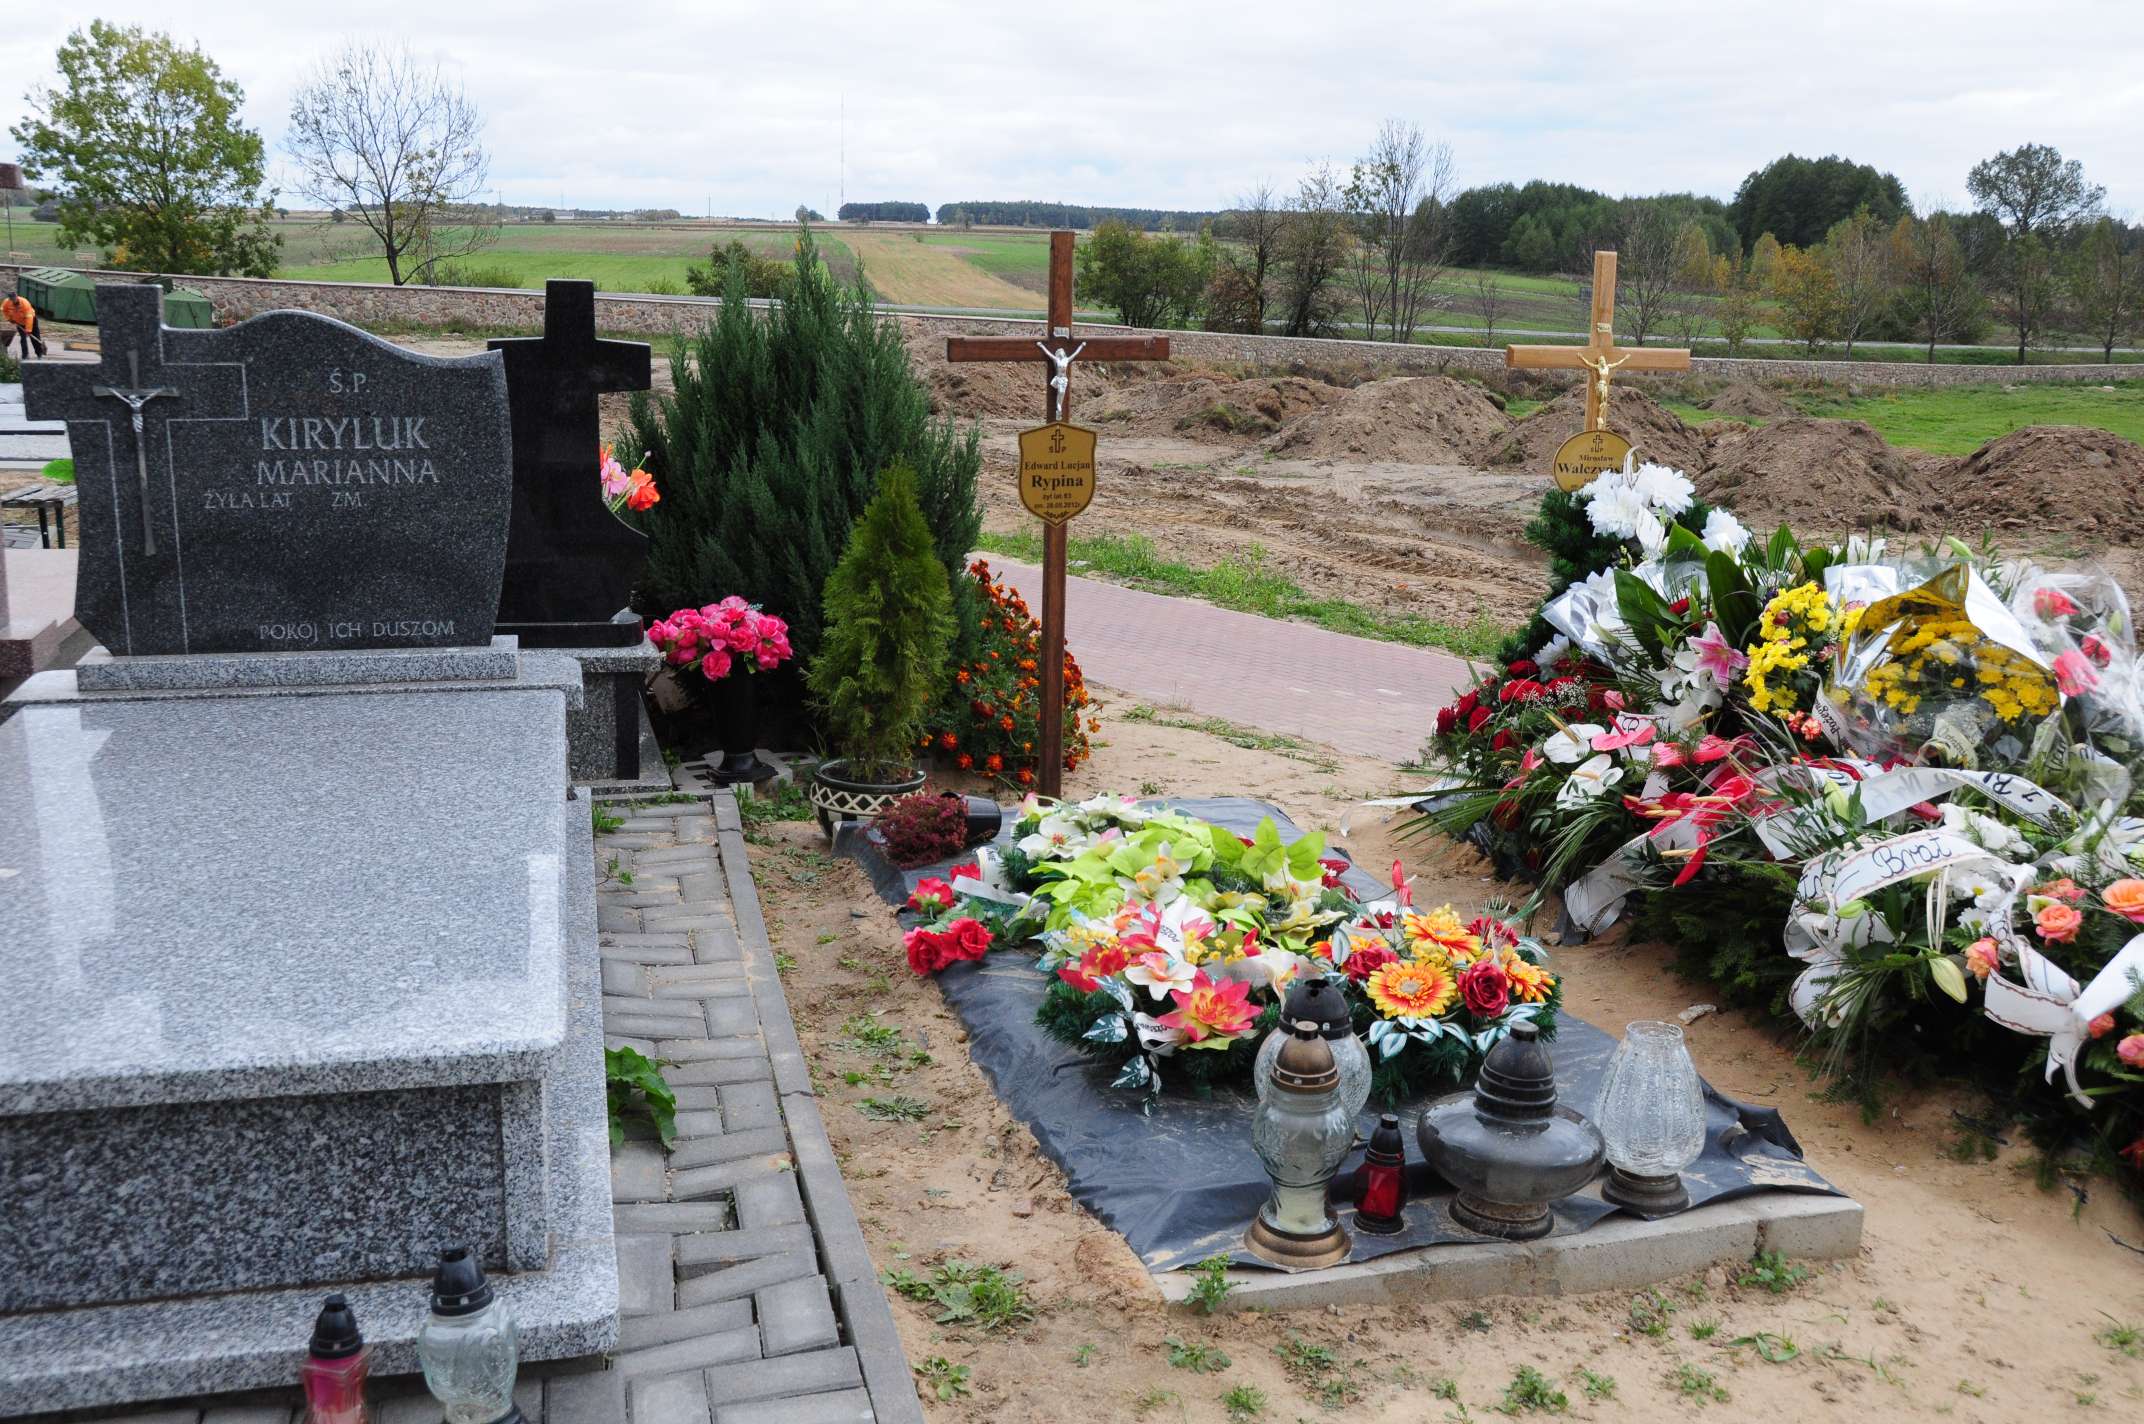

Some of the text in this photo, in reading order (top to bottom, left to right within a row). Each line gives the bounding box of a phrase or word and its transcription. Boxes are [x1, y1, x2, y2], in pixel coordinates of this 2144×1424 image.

[328, 366, 371, 394] Ś.P.
[261, 416, 430, 450] KIRYLUK
[257, 459, 440, 485] MARIANNA
[1025, 462, 1090, 471] Edward Lucjan
[1031, 475, 1083, 490] Rypina
[260, 491, 294, 509] LAT
[328, 622, 362, 639] ICH
[372, 619, 456, 638] DUSZOM
